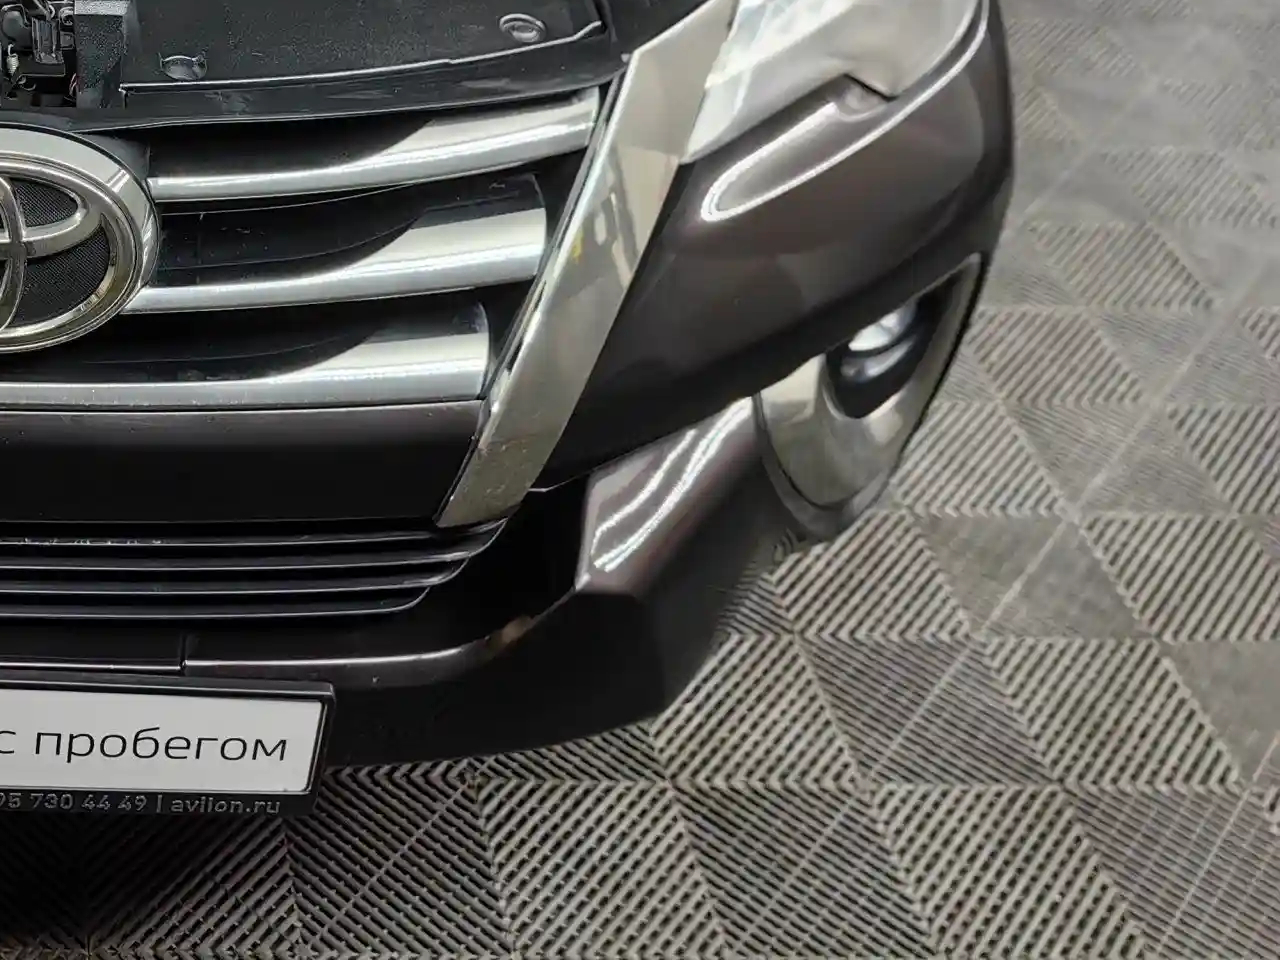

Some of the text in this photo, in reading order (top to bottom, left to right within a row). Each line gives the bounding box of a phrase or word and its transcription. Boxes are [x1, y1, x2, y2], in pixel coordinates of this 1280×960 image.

[34, 726, 288, 764] пробегом
[30, 793, 74, 810] 730
[81, 795, 112, 811] 44
[117, 795, 147, 812] 49
[170, 796, 281, 815] avilon.ru
